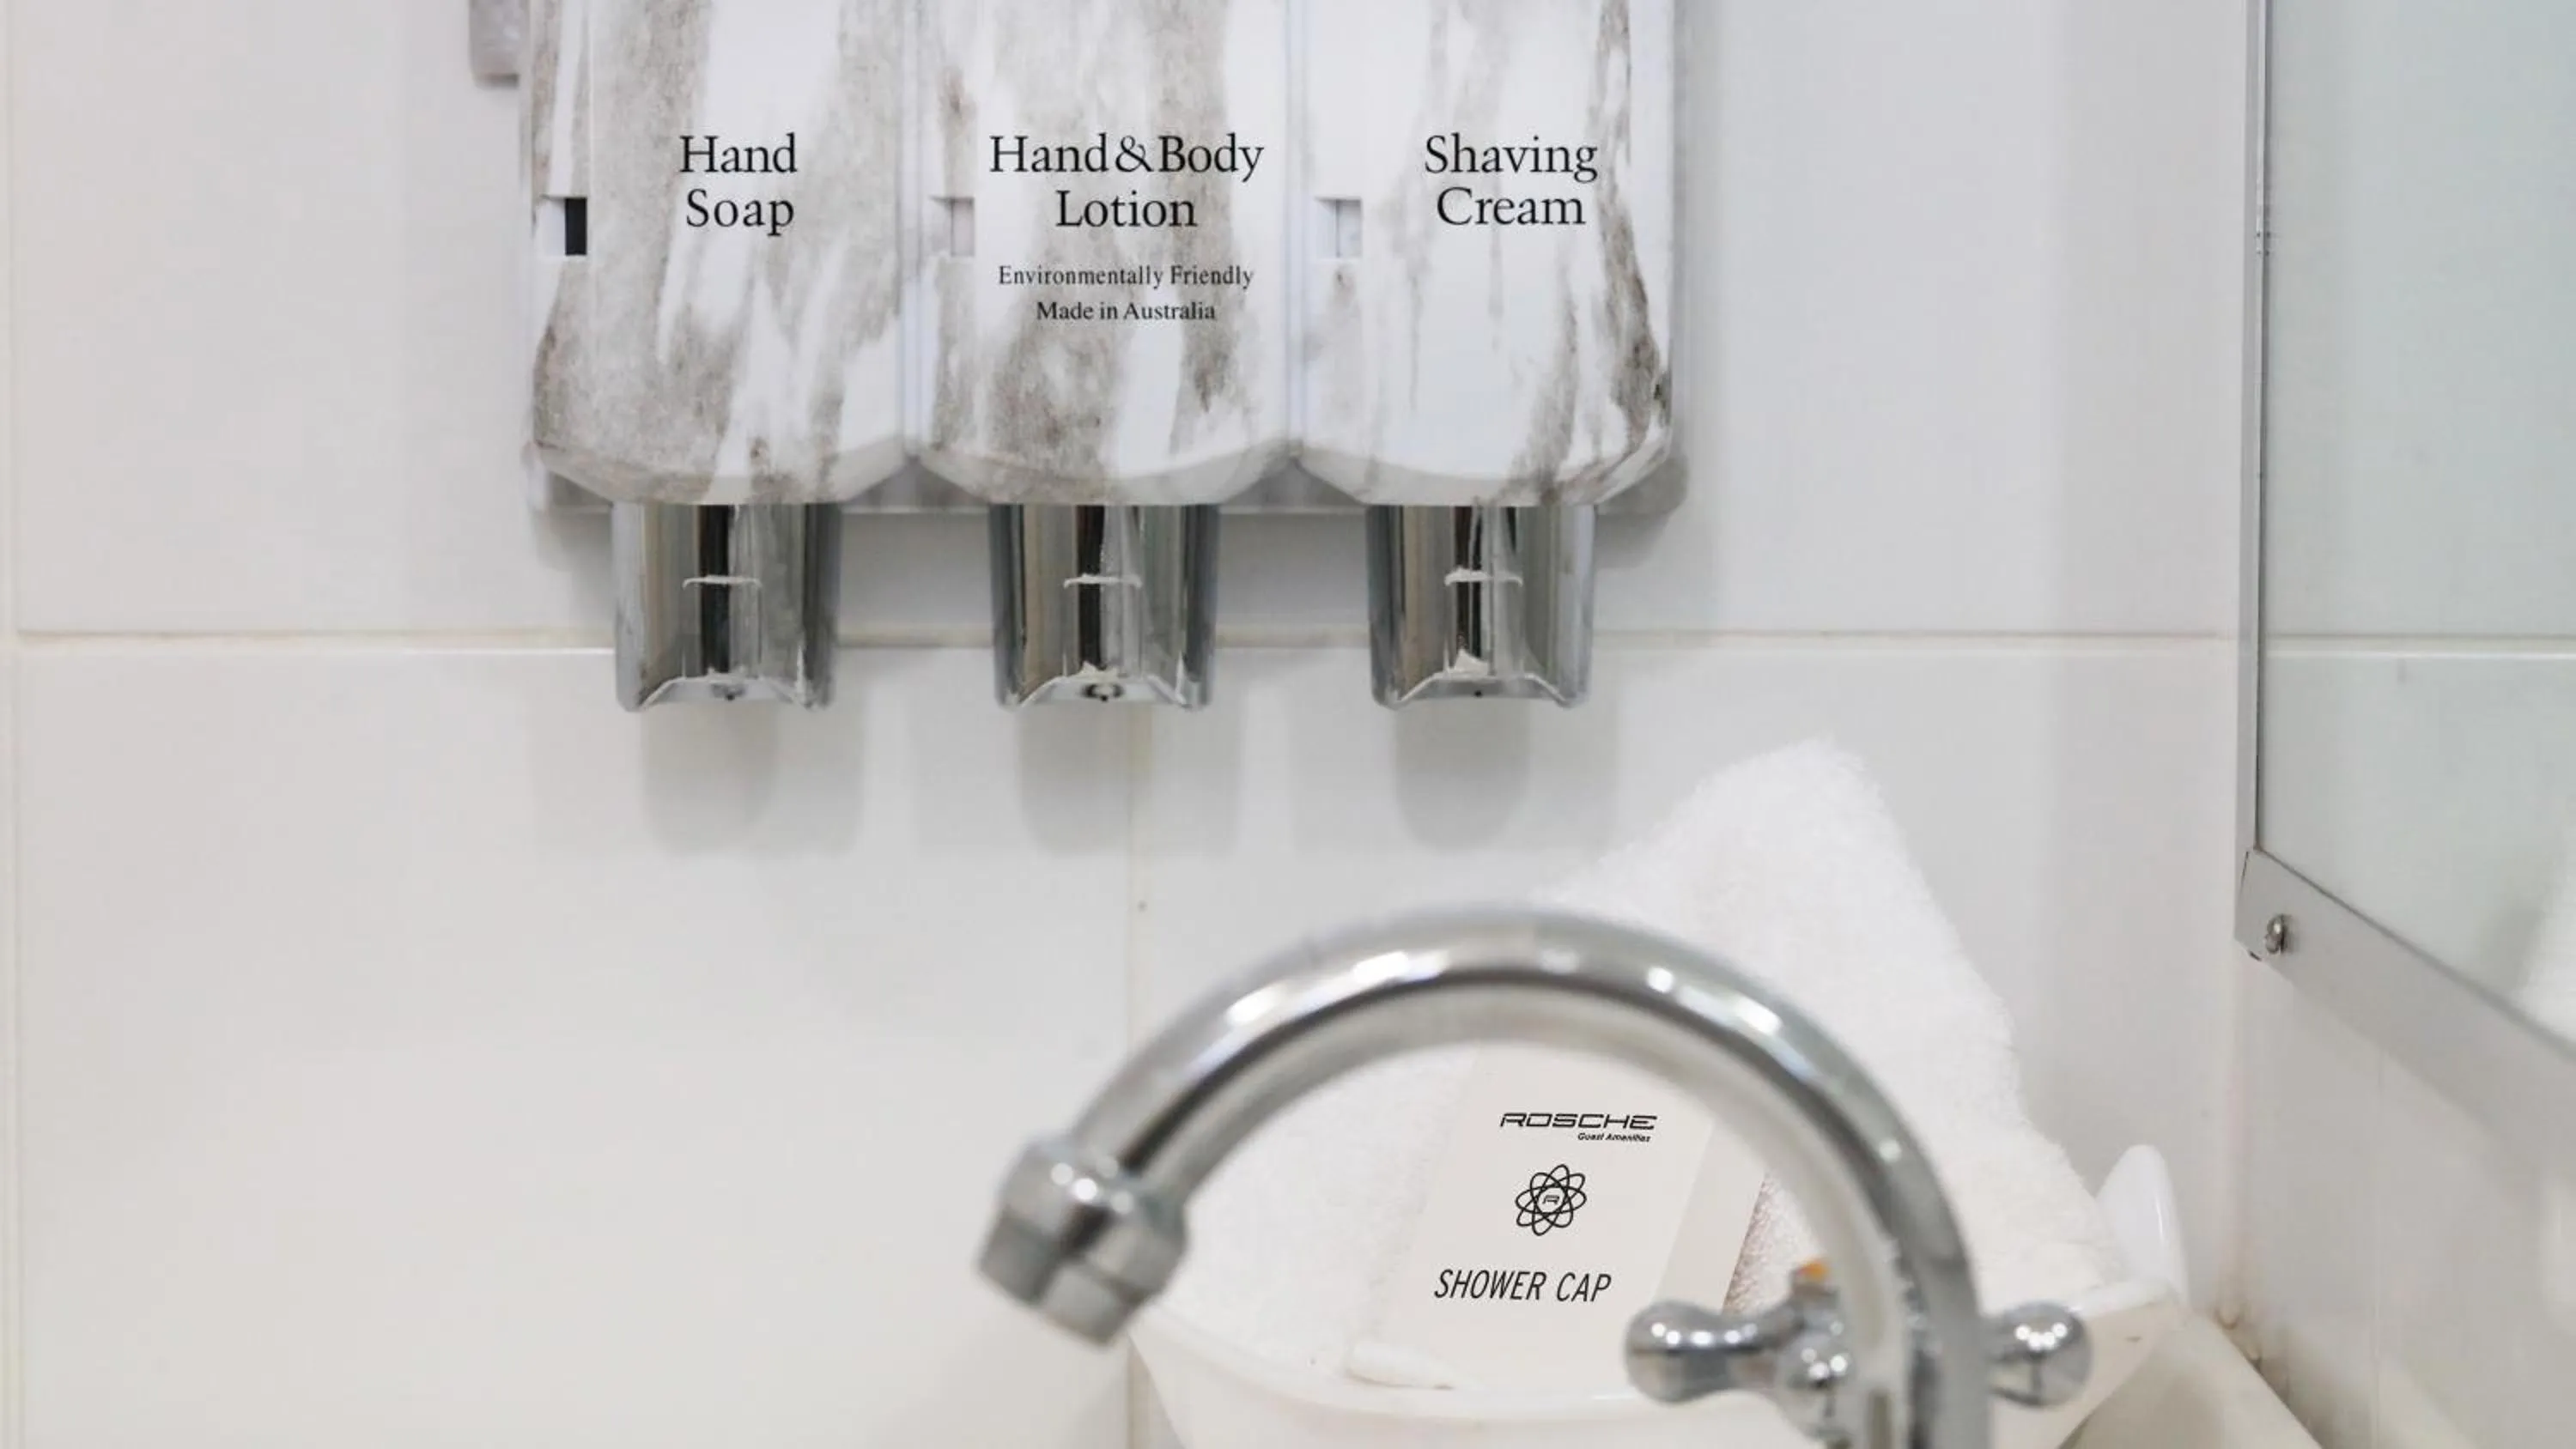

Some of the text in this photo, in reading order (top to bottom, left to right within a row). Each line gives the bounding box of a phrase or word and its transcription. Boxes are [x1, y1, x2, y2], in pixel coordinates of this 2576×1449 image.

[679, 131, 798, 173] Hand
[1425, 131, 1599, 183] Shaving
[686, 189, 795, 237] Soap
[1055, 189, 1198, 228] Lotion
[1437, 185, 1587, 226] Cream
[999, 264, 1254, 290] Environmentally Friendly
[1036, 300, 1216, 320] Made in Australia
[1499, 1112, 1659, 1131] ROSCHE
[1433, 1268, 1613, 1303] SHOWER CAP
